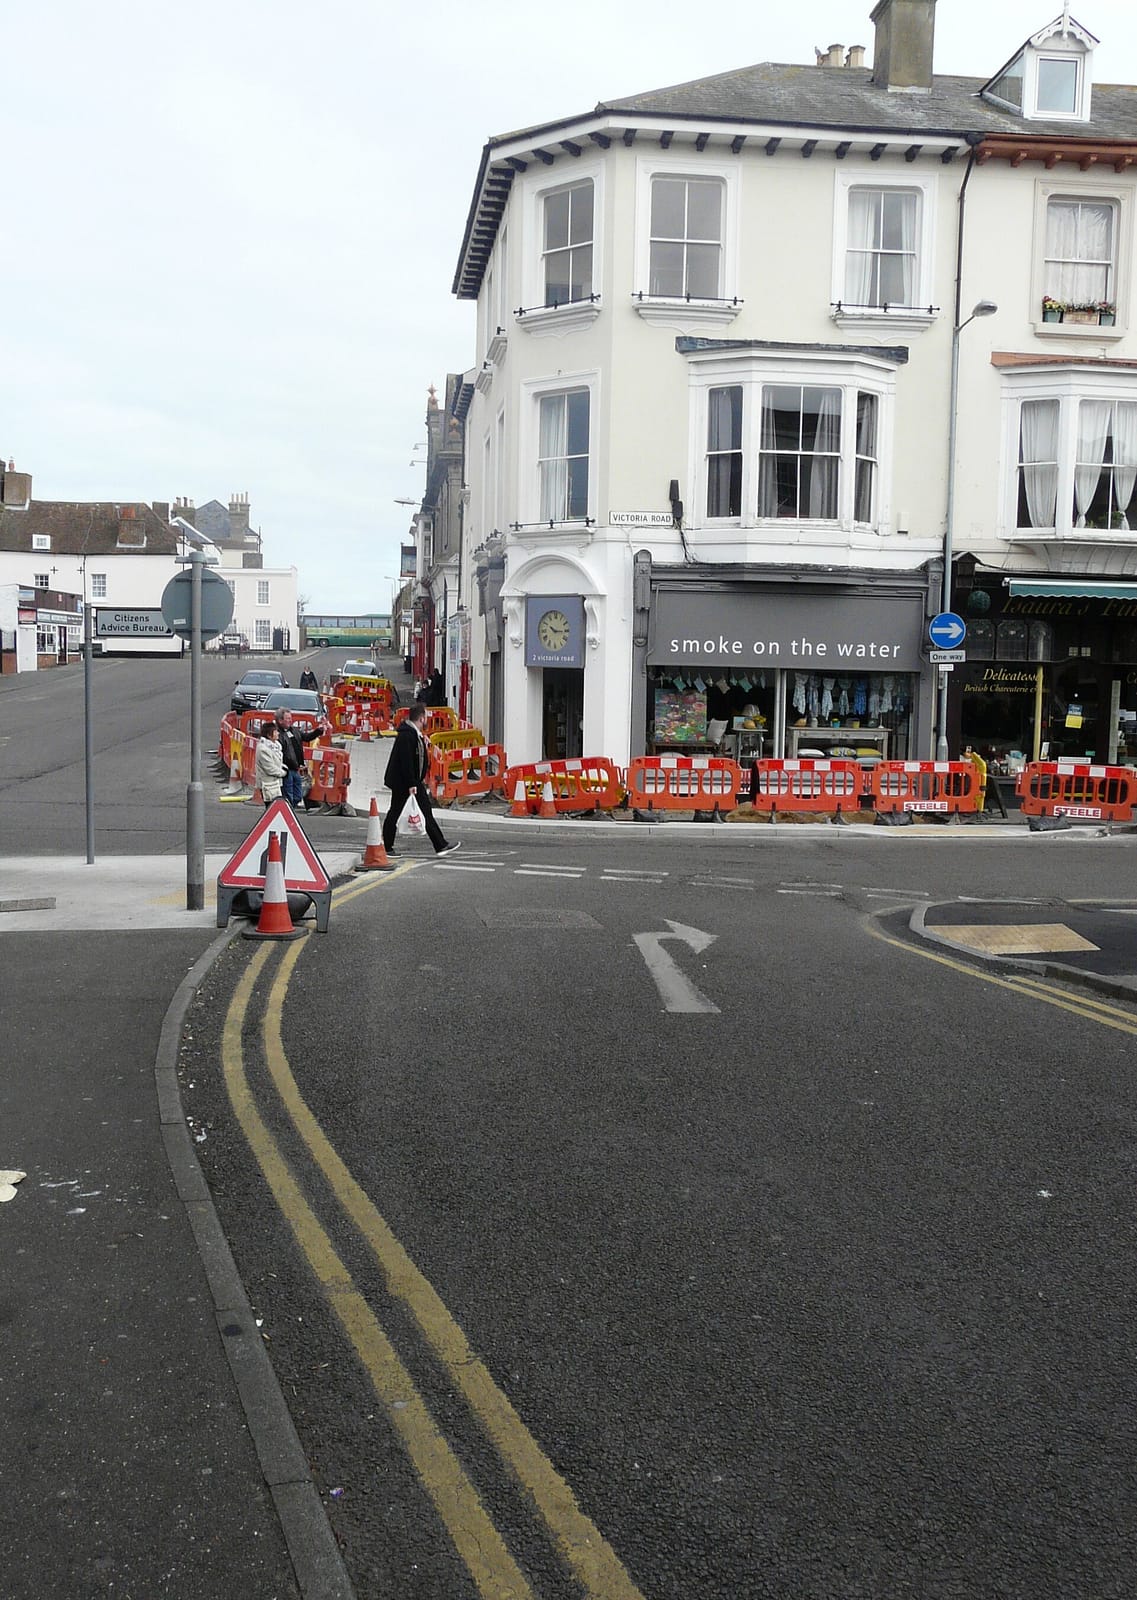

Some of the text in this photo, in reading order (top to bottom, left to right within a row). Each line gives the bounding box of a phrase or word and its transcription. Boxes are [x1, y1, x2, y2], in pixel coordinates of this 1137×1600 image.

[613, 514, 672, 523] VICTORIA ROAD
[114, 614, 150, 623] Citizens
[101, 623, 165, 633] Advice Bureau
[670, 635, 901, 658] smoke on the water
[932, 653, 963, 662] One way
[904, 802, 948, 811] STEELE
[1055, 807, 1101, 817] STEELE
